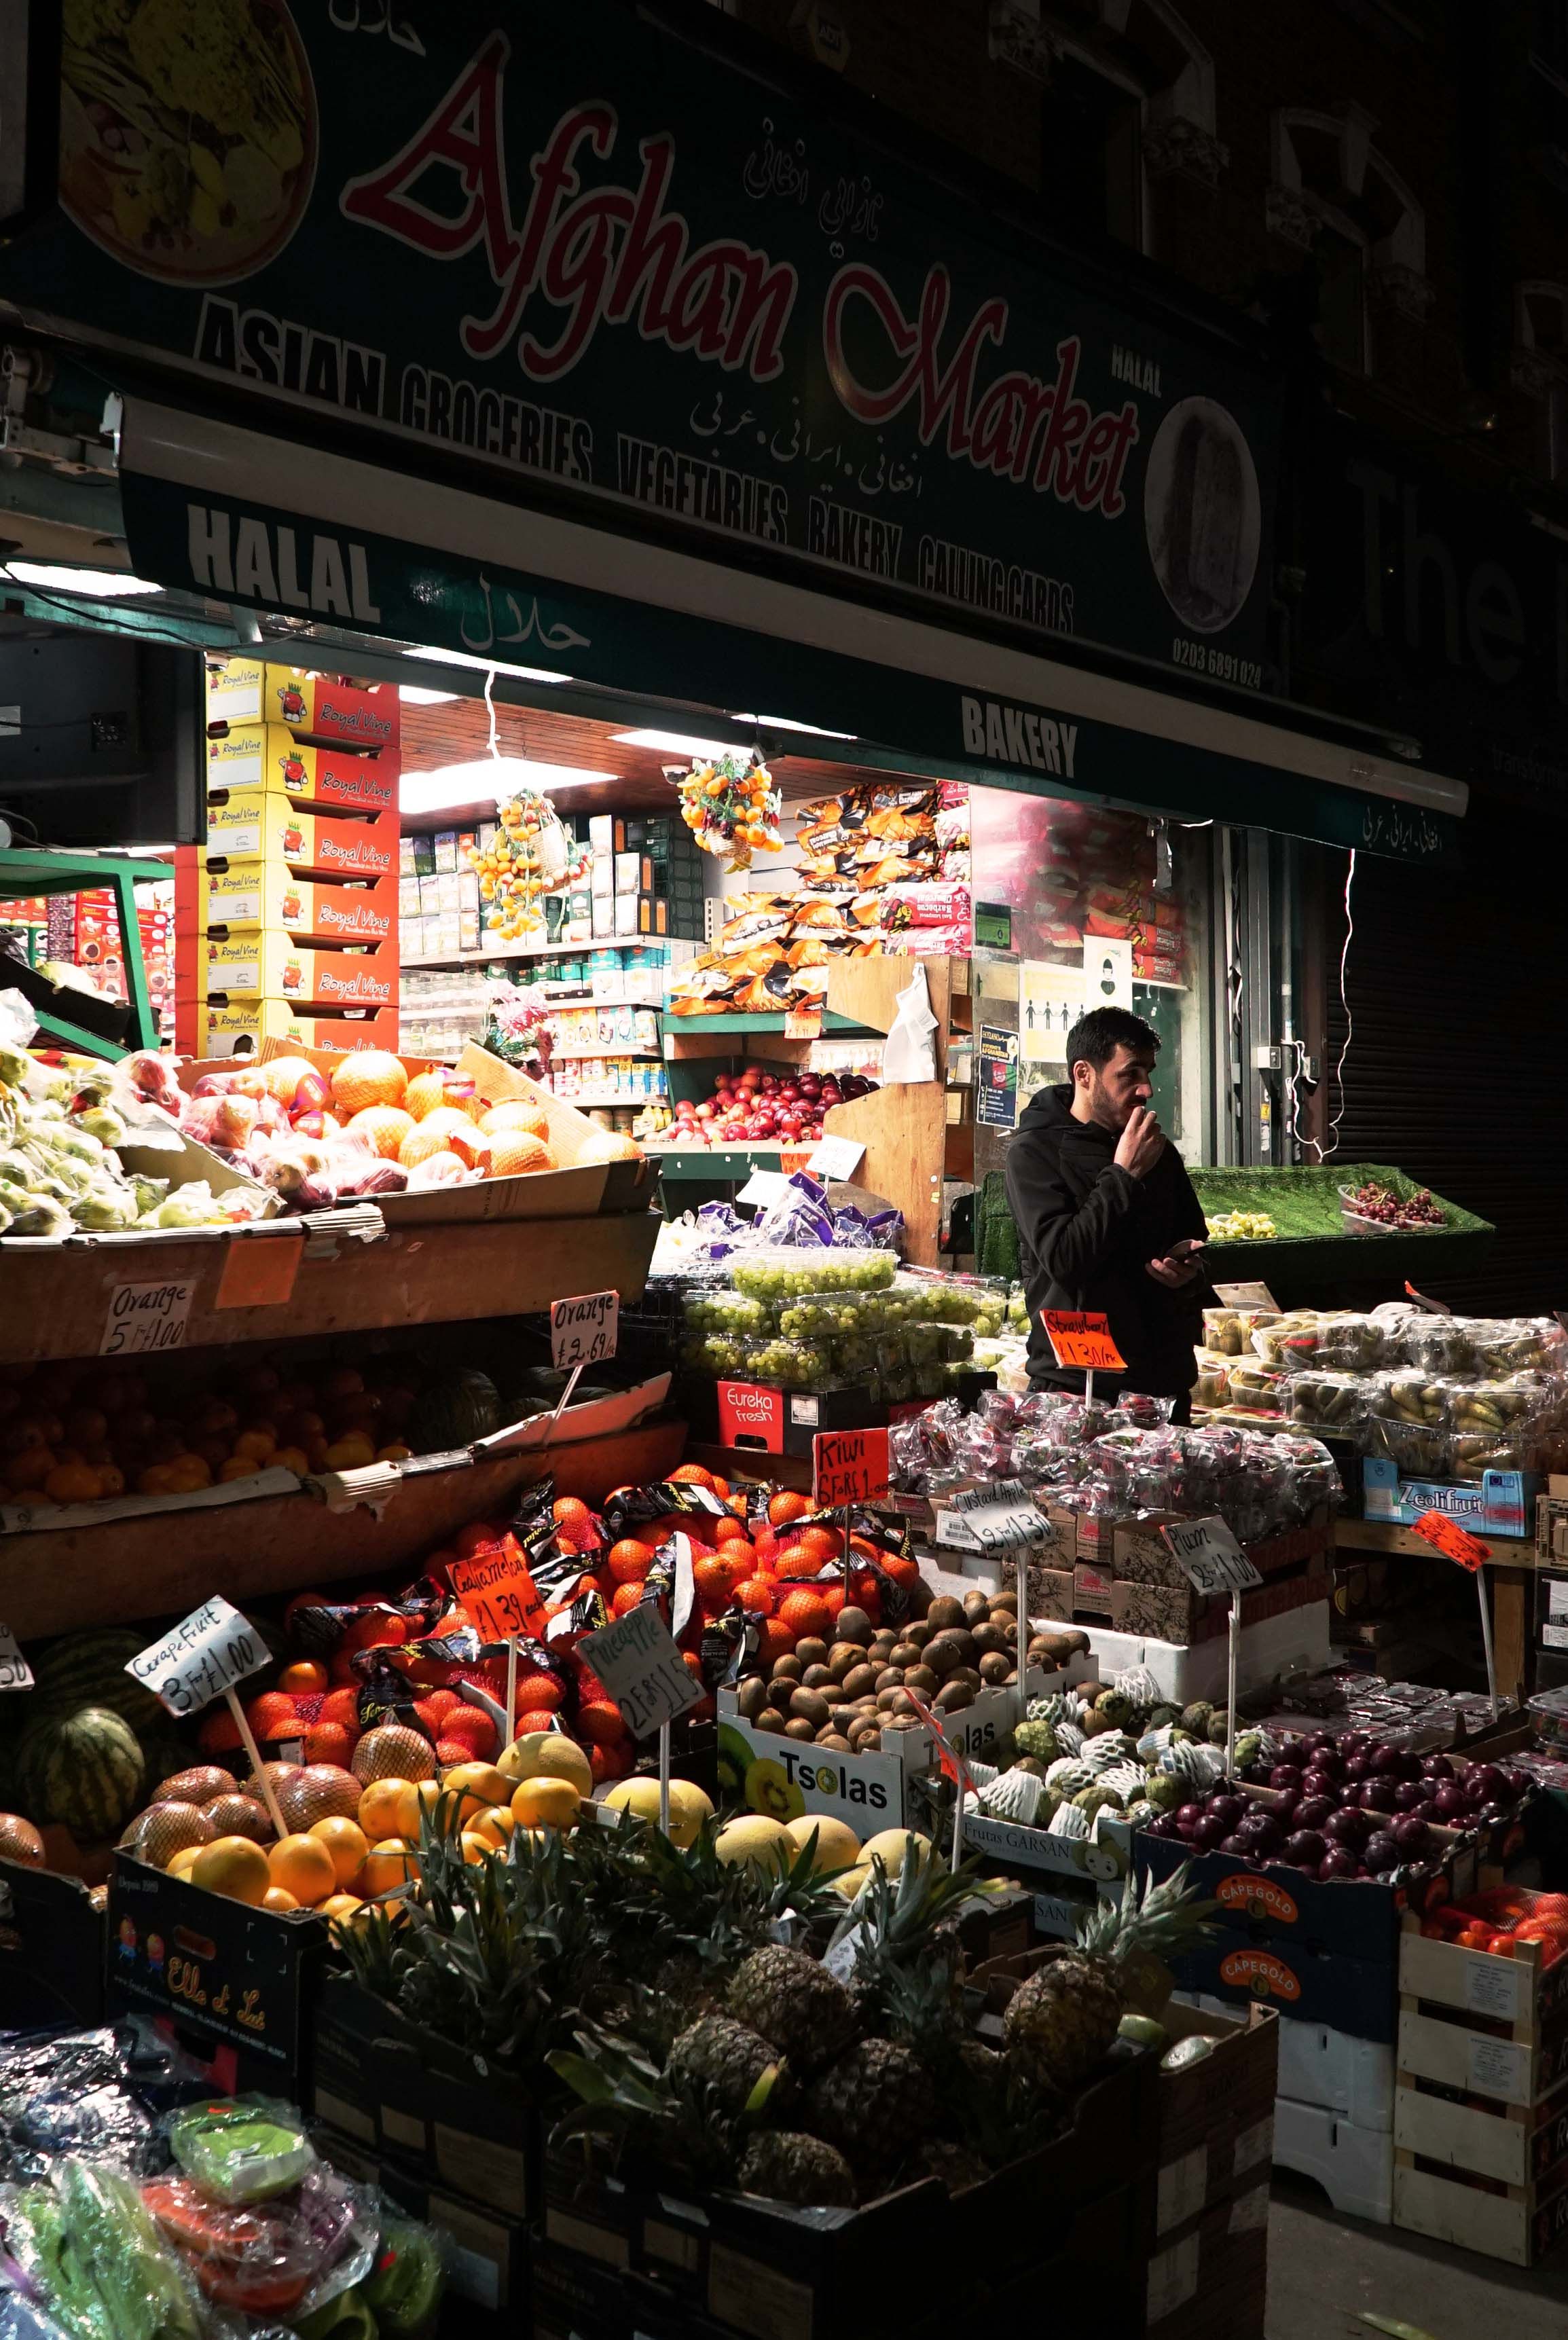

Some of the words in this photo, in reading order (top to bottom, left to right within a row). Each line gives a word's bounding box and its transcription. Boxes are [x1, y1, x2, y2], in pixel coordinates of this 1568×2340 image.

[340, 28, 799, 383] Afghan
[823, 262, 1139, 519] Market
[193, 292, 386, 412] ASIAN
[1110, 344, 1163, 398] HALAL
[187, 504, 381, 624] HALAL
[1346, 456, 1526, 684] The
[459, 571, 592, 651] حلال
[223, 670, 244, 687] Royal
[244, 671, 259, 681] Vine
[320, 703, 363, 732] Royal
[364, 712, 392, 732] Vine
[223, 739, 245, 756] Royal
[245, 740, 261, 750] Vine
[962, 695, 1078, 779] BAKERY
[321, 771, 365, 800] Royal
[365, 780, 393, 800] Vine
[221, 807, 243, 824] Royal
[243, 808, 260, 819] Vine
[319, 839, 363, 866] Royal
[363, 845, 390, 864] Vine
[223, 875, 244, 891] Royal
[244, 876, 260, 886] Vine
[318, 904, 362, 932] Royal
[362, 910, 390, 929] Vine
[221, 943, 243, 960] Royal
[243, 945, 259, 955] Vine
[318, 972, 363, 1000] Royal
[363, 976, 390, 995] Vine
[221, 1013, 243, 1030] Royal
[244, 1014, 259, 1024] Vine
[113, 1286, 186, 1317] Orange
[555, 1296, 613, 1329] Orange
[107, 1321, 131, 1354] 5
[727, 1388, 773, 1410] Eureka
[735, 1409, 773, 1423] fresh
[819, 1433, 865, 1473] Kiwi
[955, 1483, 999, 1514] Custard
[1000, 1480, 1027, 1505] Apple
[1398, 1484, 1484, 1514] Zeolifruit
[983, 1528, 1004, 1552] 2
[1167, 1527, 1211, 1556] Plum
[1191, 1565, 1214, 1588] 8
[162, 1677, 193, 1711] 3
[618, 1698, 646, 1730] 2
[964, 1822, 1003, 1844] Frutas
[1006, 1833, 1070, 1859] GARSAN
[1035, 1901, 1068, 1922] SAN
[1221, 1885, 1292, 1914] CAPEGOLD
[1224, 1960, 1295, 1990] CAPEGOLD
